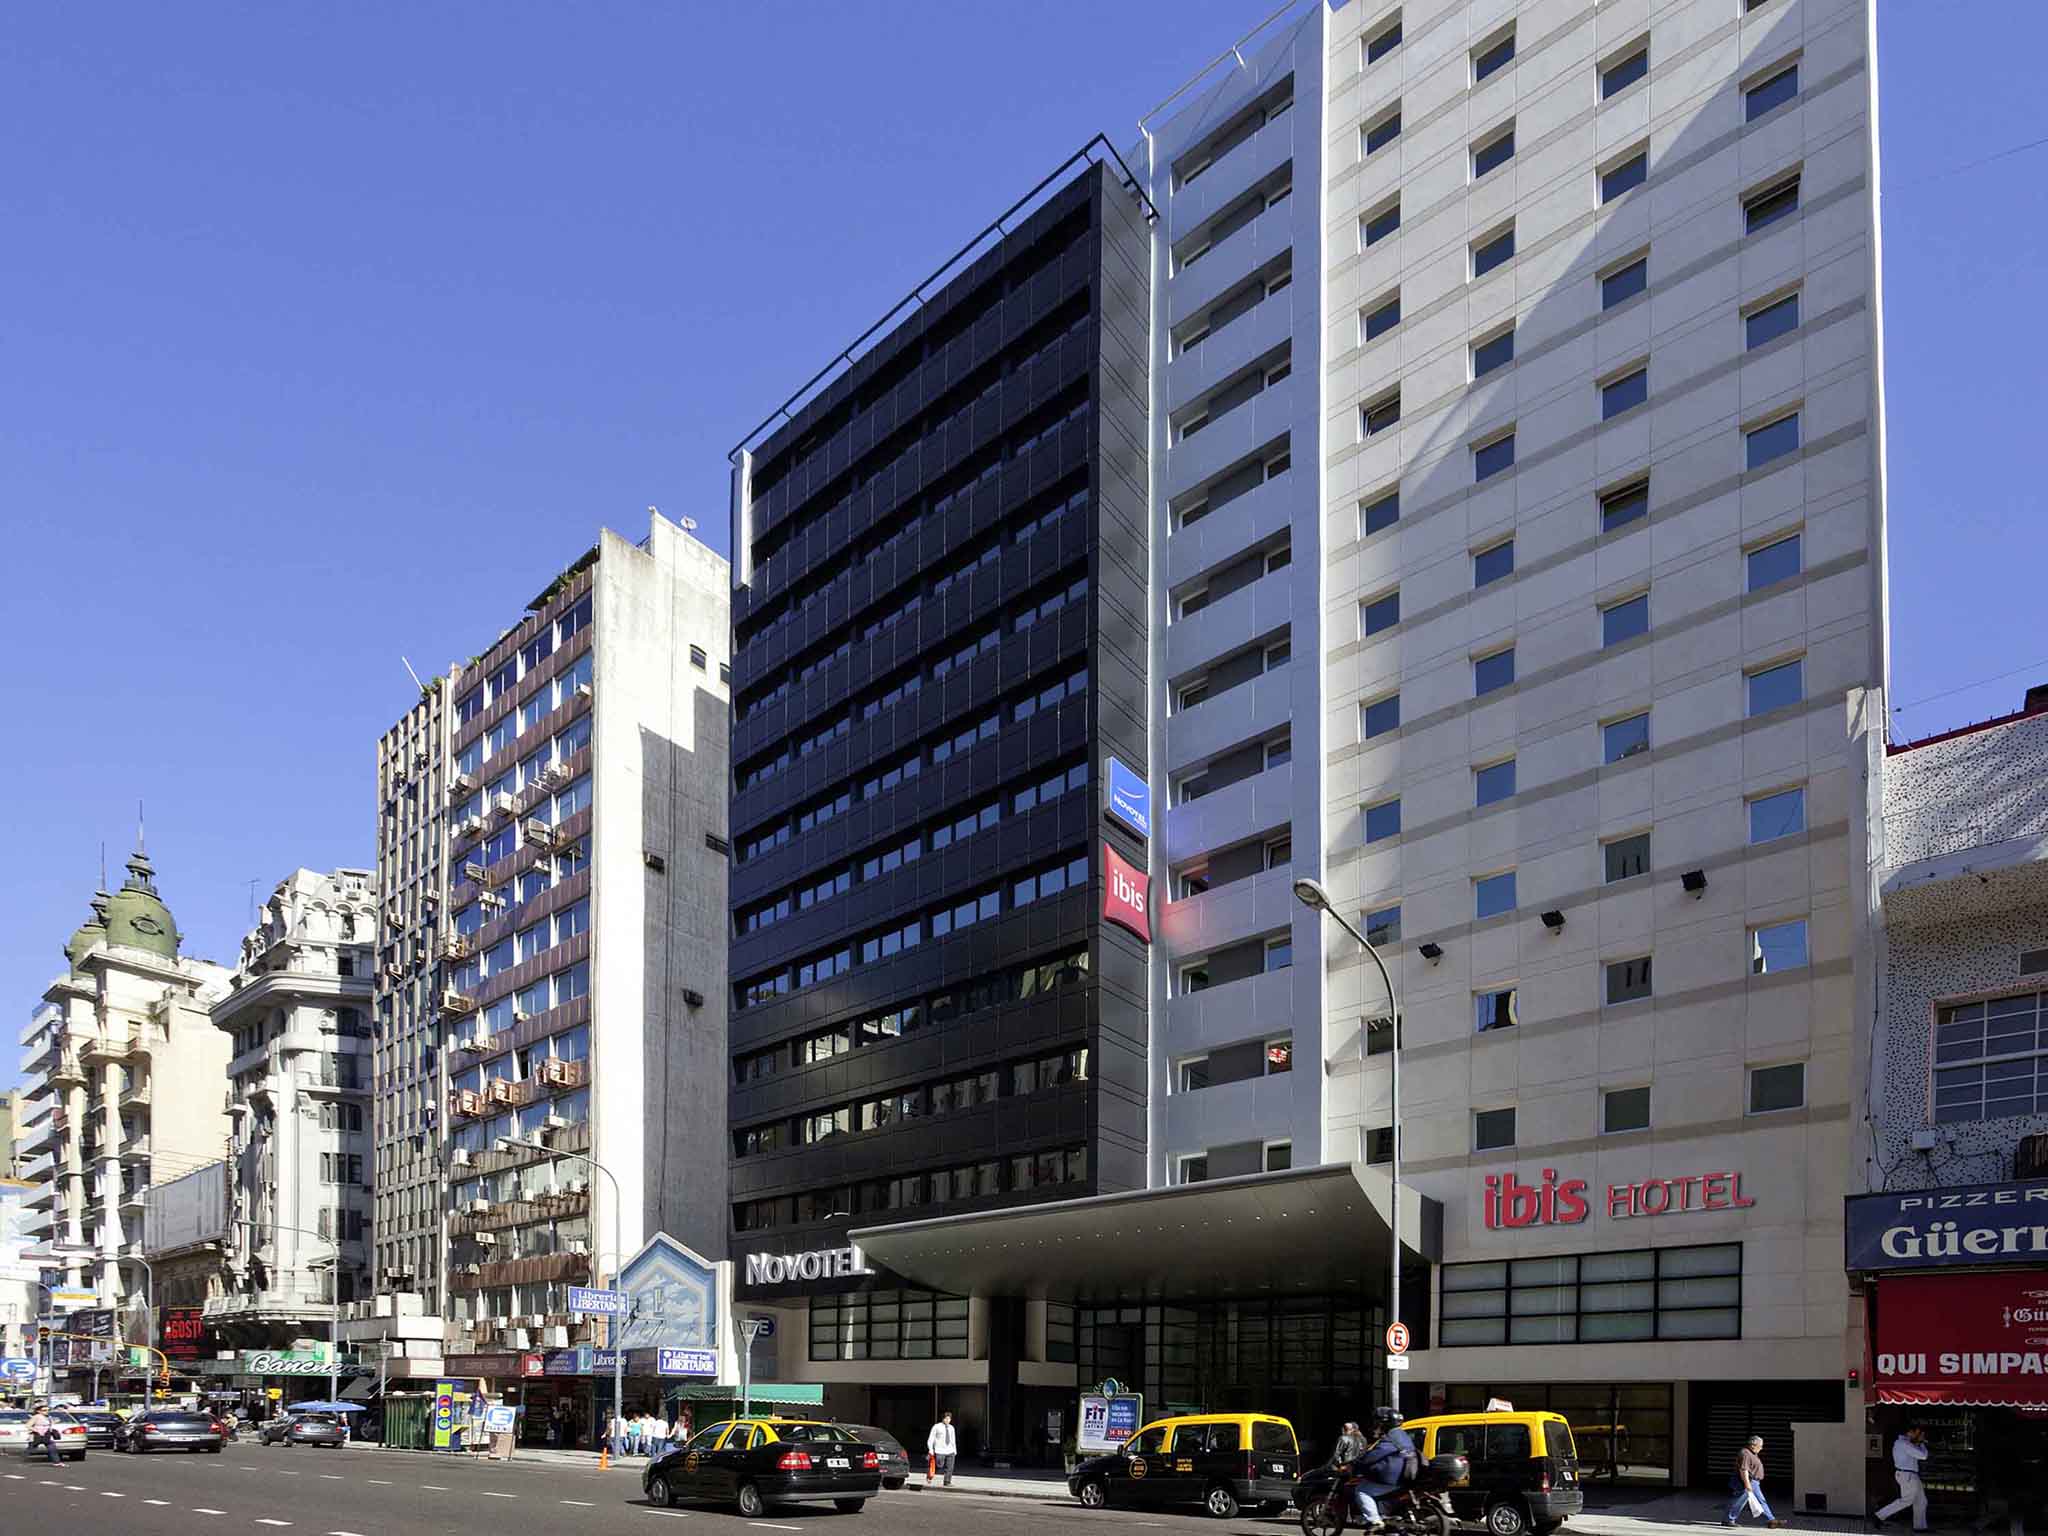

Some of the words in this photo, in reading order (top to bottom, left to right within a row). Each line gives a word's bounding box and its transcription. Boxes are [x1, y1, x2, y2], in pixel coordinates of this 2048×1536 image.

[1113, 793, 1146, 823] NOVOTEL
[1113, 869, 1144, 913] ibis
[1484, 1168, 1588, 1230] ibis
[1607, 1171, 1755, 1219] HOTEL
[745, 1240, 876, 1286] NOVOTEL
[2013, 1306, 2048, 1323] Gü
[1876, 1353, 1926, 1376] QUI
[1938, 1352, 2048, 1375] SIMPA
